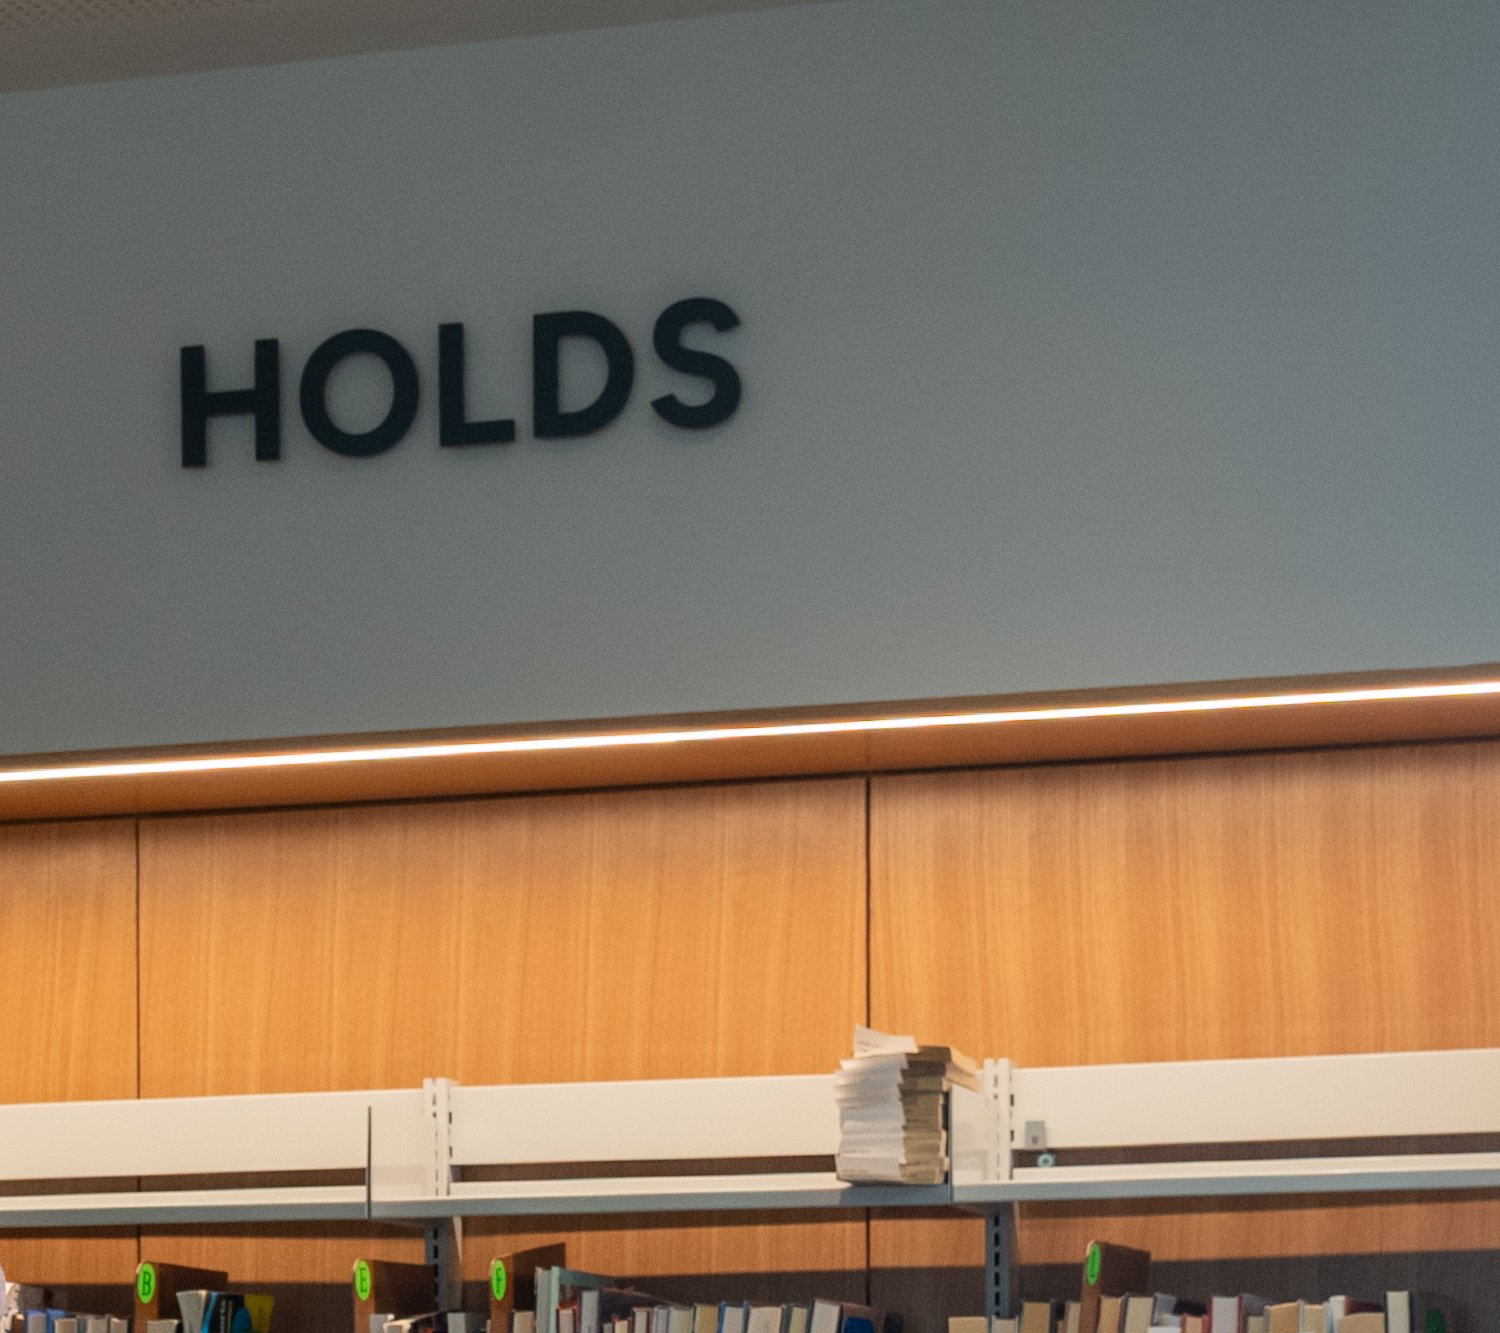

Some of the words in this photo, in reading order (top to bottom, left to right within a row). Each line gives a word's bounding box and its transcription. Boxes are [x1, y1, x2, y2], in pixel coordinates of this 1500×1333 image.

[179, 297, 743, 469] HOLDS
[142, 1271, 151, 1296] B
[359, 1267, 368, 1293] E
